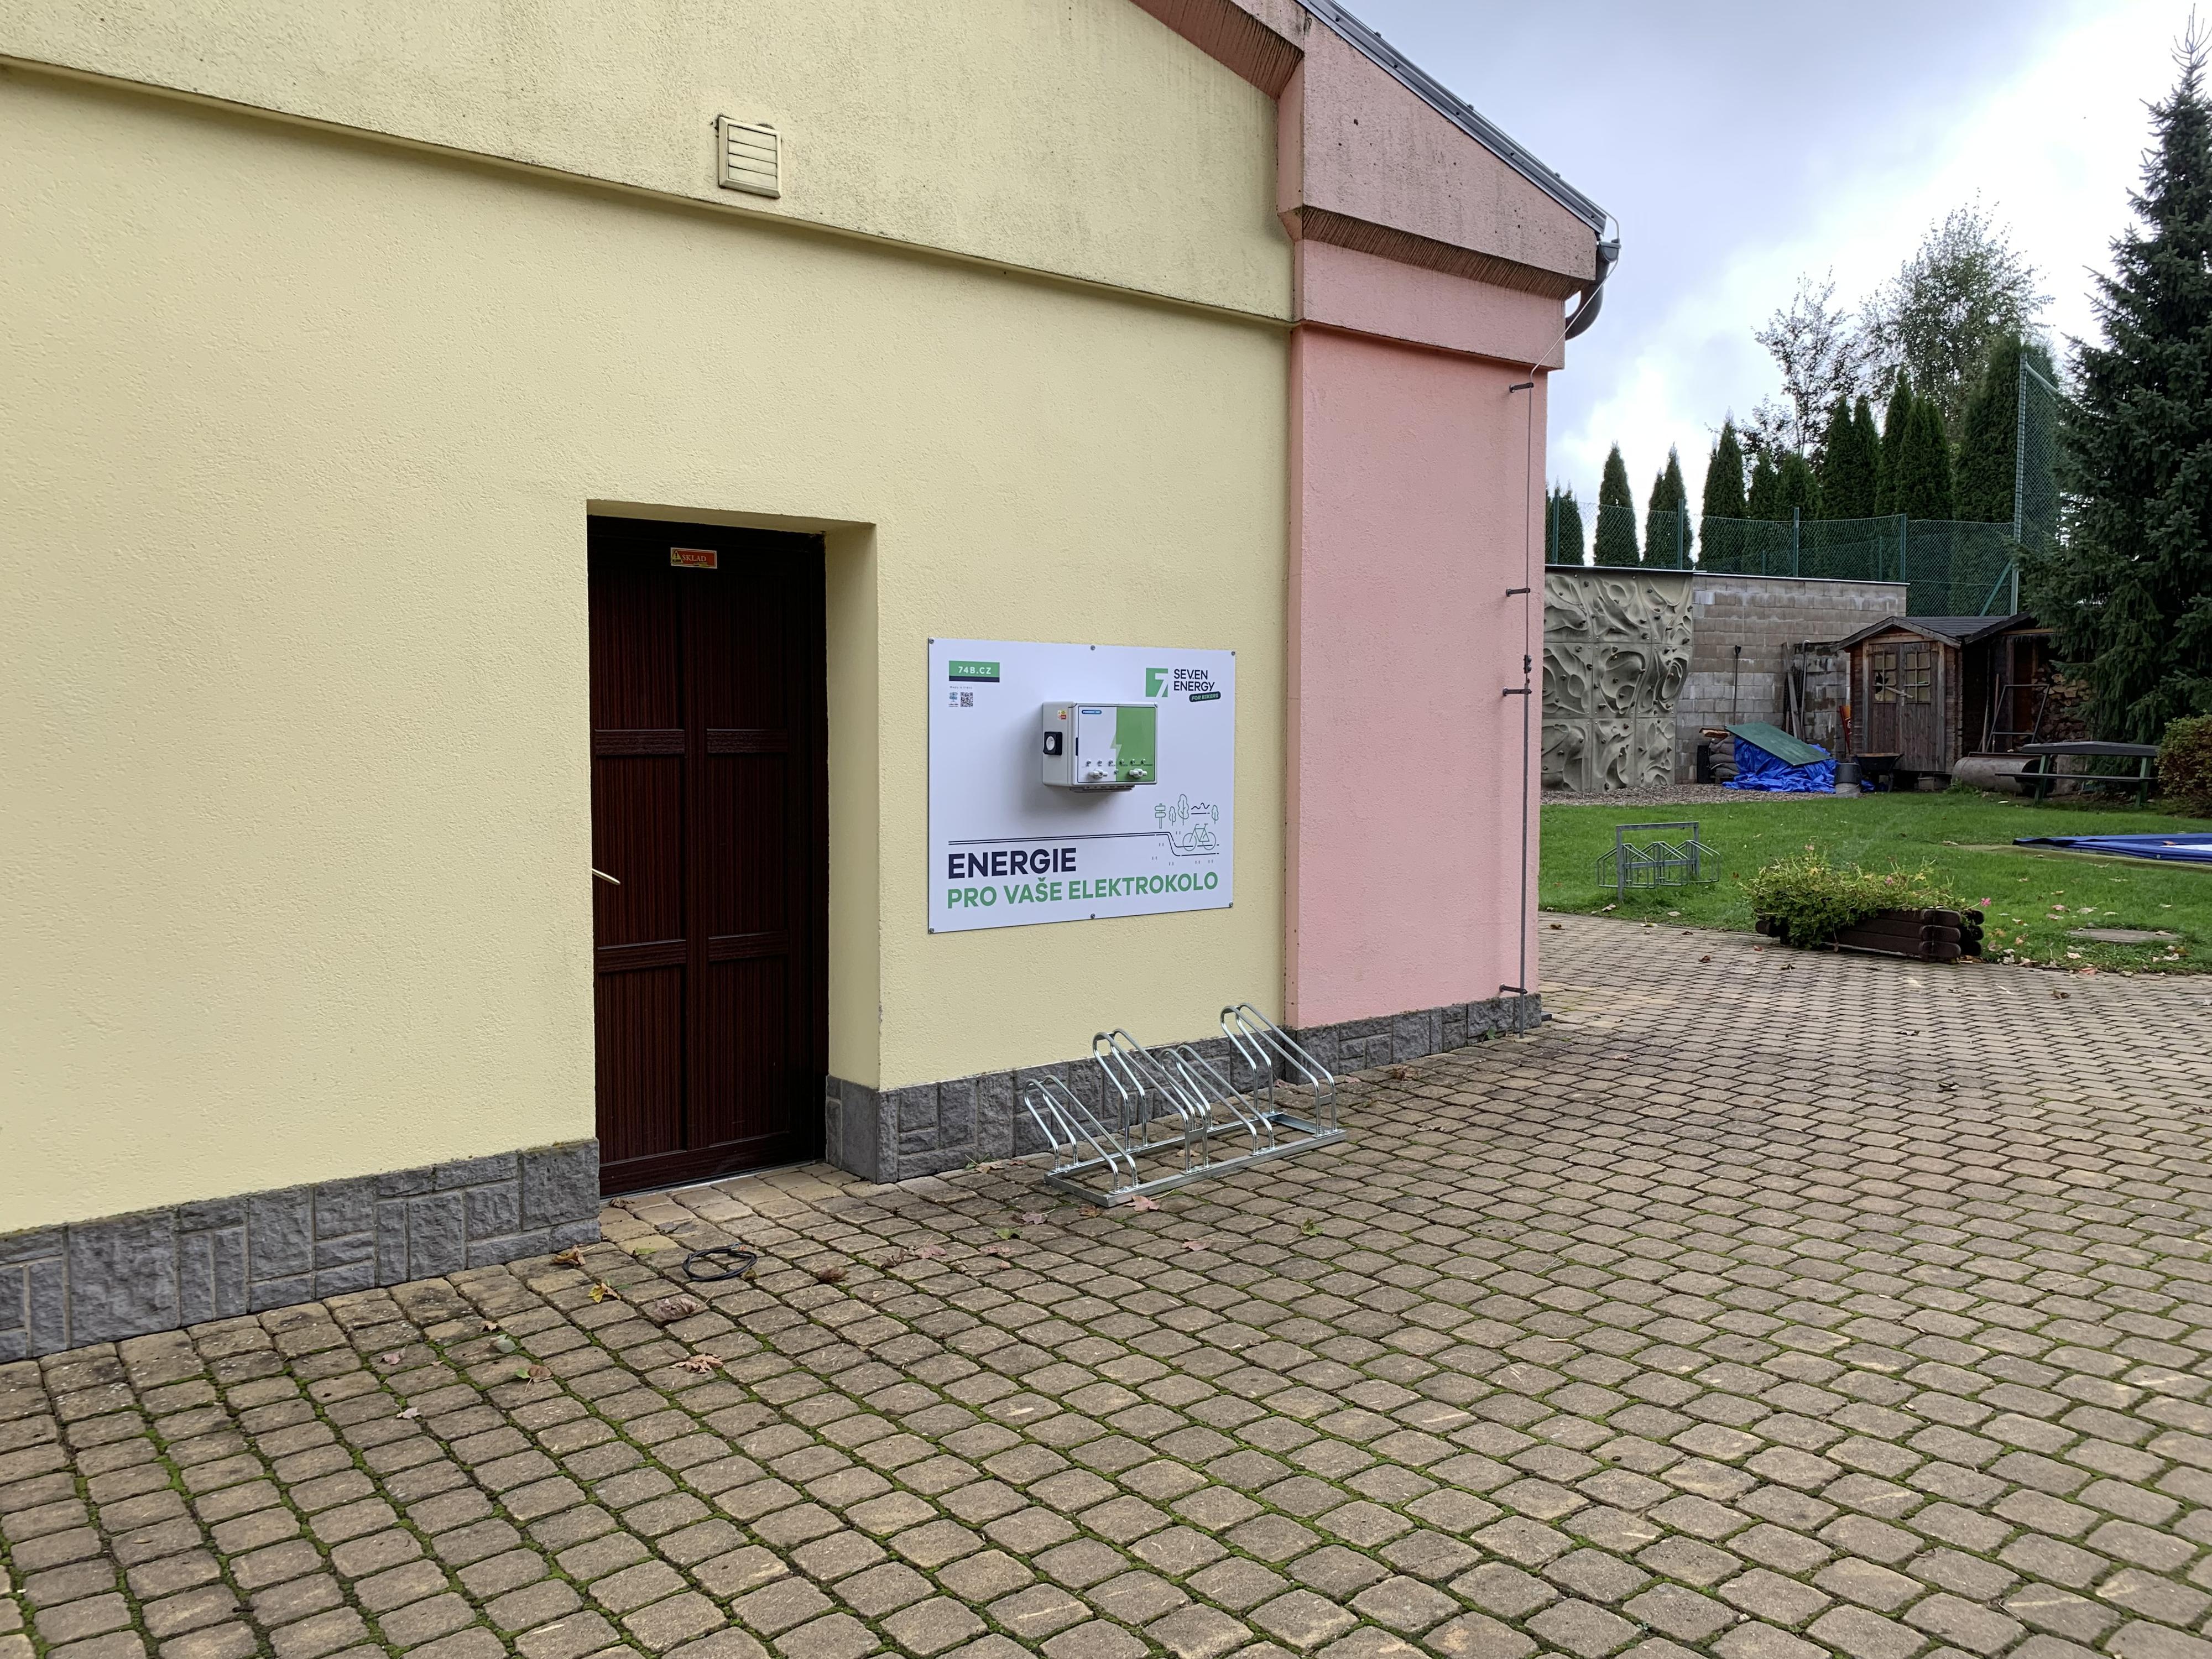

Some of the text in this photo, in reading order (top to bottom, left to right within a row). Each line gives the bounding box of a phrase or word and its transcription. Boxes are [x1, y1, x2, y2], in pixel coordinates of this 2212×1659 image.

[958, 666, 991, 674] 74B.CZ
[1173, 681, 1214, 691] ENERGY
[948, 847, 1076, 878] ENERGIE
[948, 872, 1218, 909] PRO VAŠE ELEKTROKOLO
